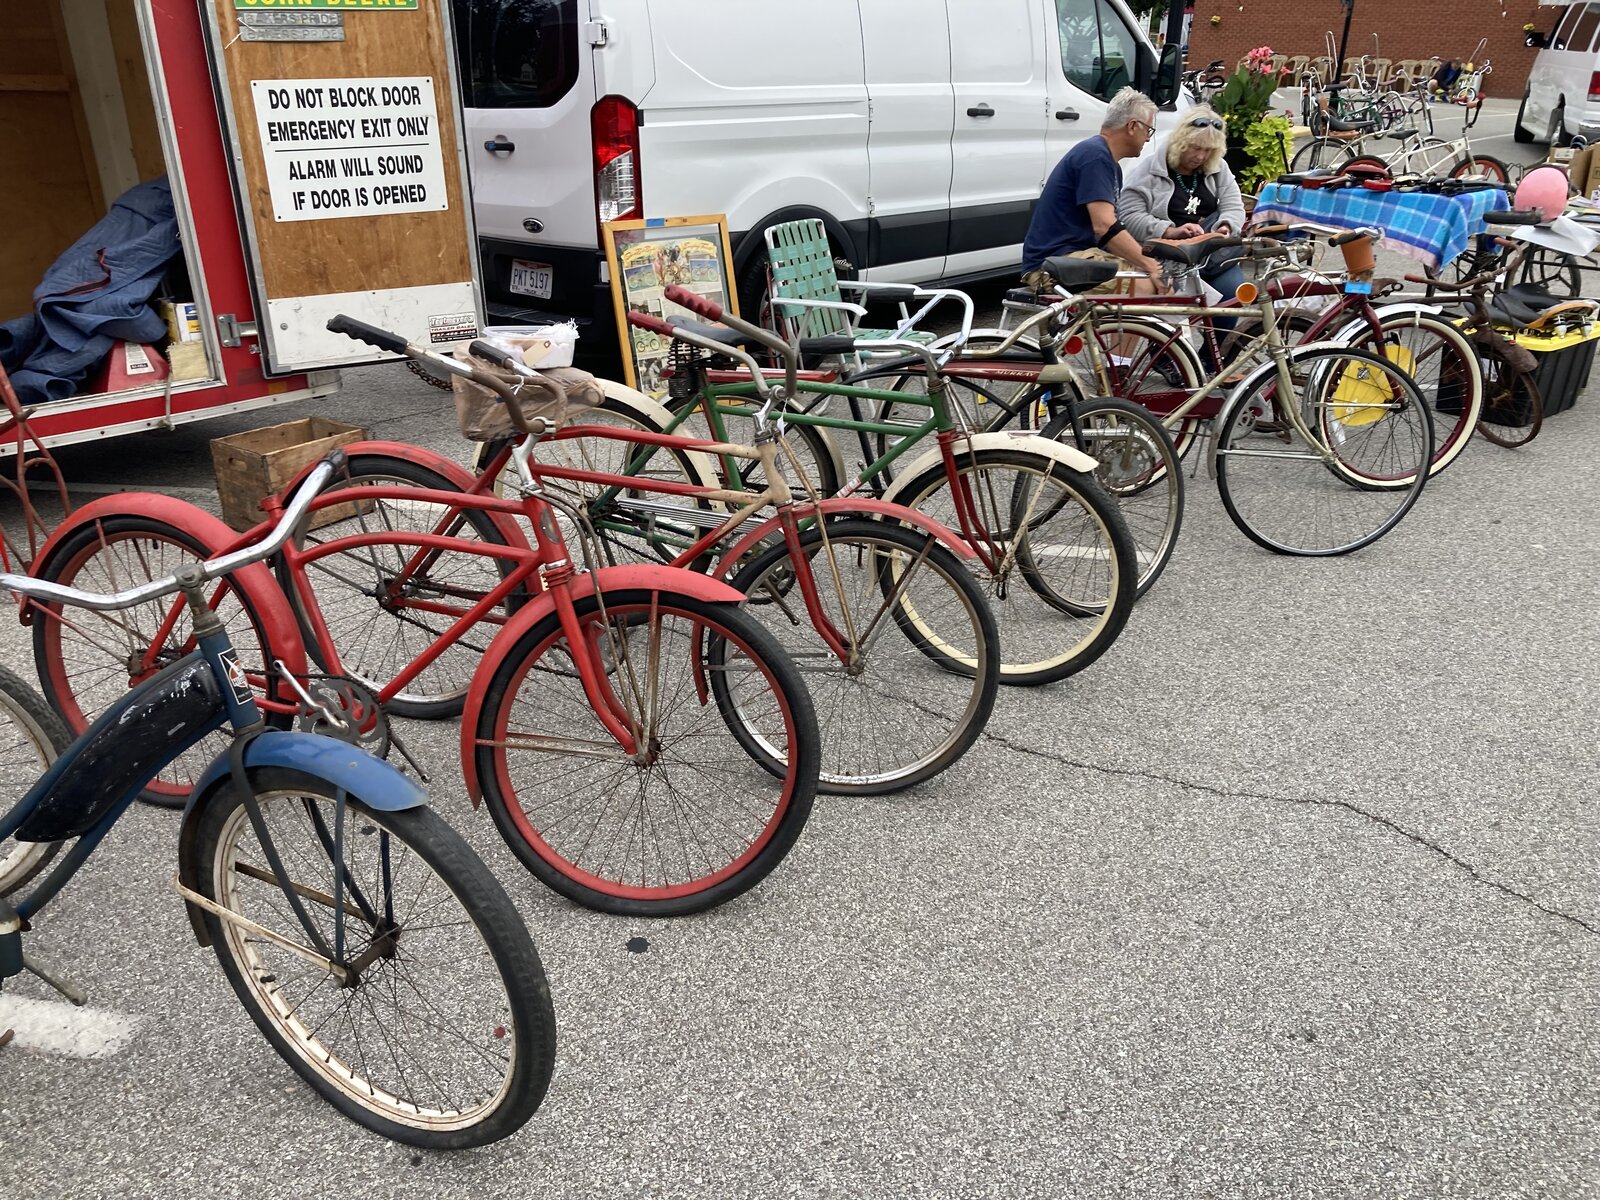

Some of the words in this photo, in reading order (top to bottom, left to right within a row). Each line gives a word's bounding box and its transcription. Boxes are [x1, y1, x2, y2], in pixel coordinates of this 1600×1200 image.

[268, 89, 290, 109] DO
[297, 88, 324, 109] NOT
[330, 87, 378, 107] BLOCK
[382, 85, 421, 106] DOOR
[267, 119, 356, 142] EMERGENCY
[361, 118, 392, 138] EXIT
[397, 116, 429, 136] ONLY
[289, 159, 337, 180] ALARM
[340, 157, 374, 177] WILL
[378, 154, 423, 176] SOUND
[292, 191, 306, 210] IF
[311, 188, 351, 209] DOOR
[355, 186, 369, 207] IS
[373, 184, 427, 205] OPENED
[513, 268, 528, 286] PKT
[530, 270, 549, 290] 5197
[996, 369, 1035, 377] MURRAY
